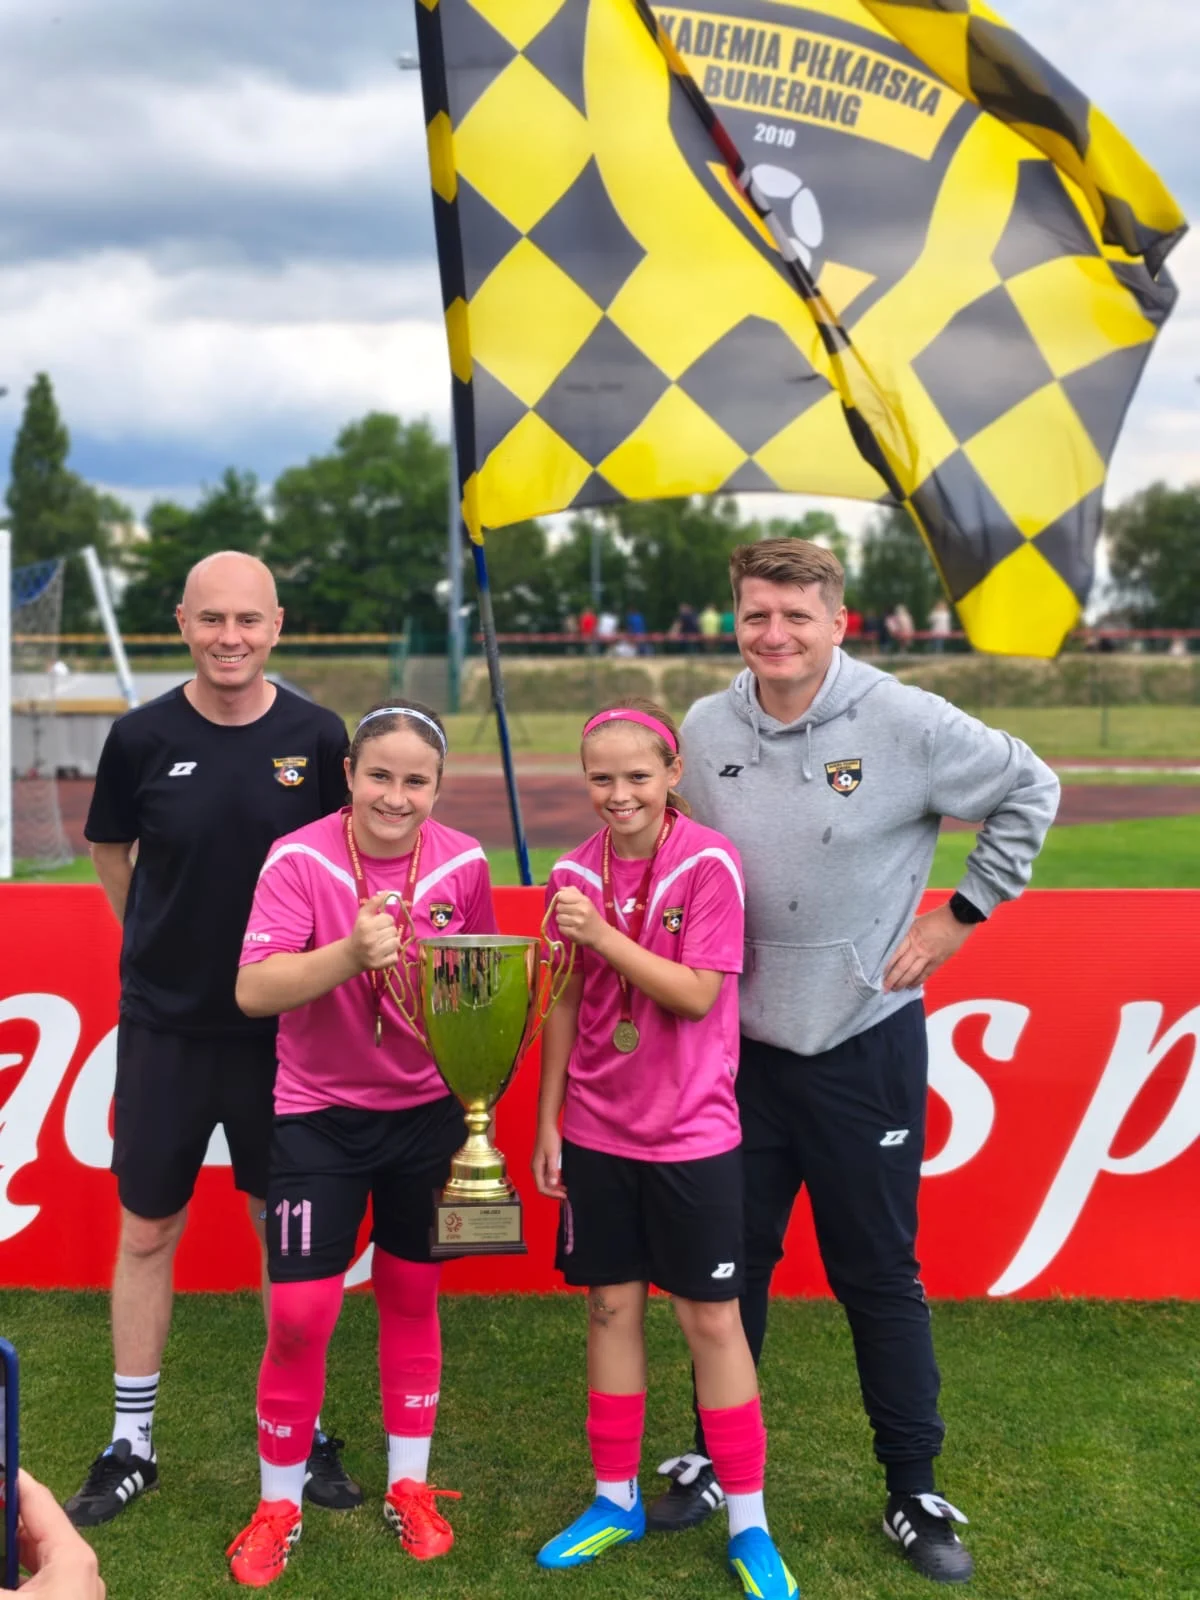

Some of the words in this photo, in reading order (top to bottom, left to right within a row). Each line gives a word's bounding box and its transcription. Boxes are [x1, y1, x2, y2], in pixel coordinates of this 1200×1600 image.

[657, 13, 781, 70] KADEMIA
[788, 37, 943, 117] PIŁKARSKA
[702, 64, 864, 127] BUMERANG
[753, 122, 797, 149] 2010
[275, 1198, 312, 1257] 11
